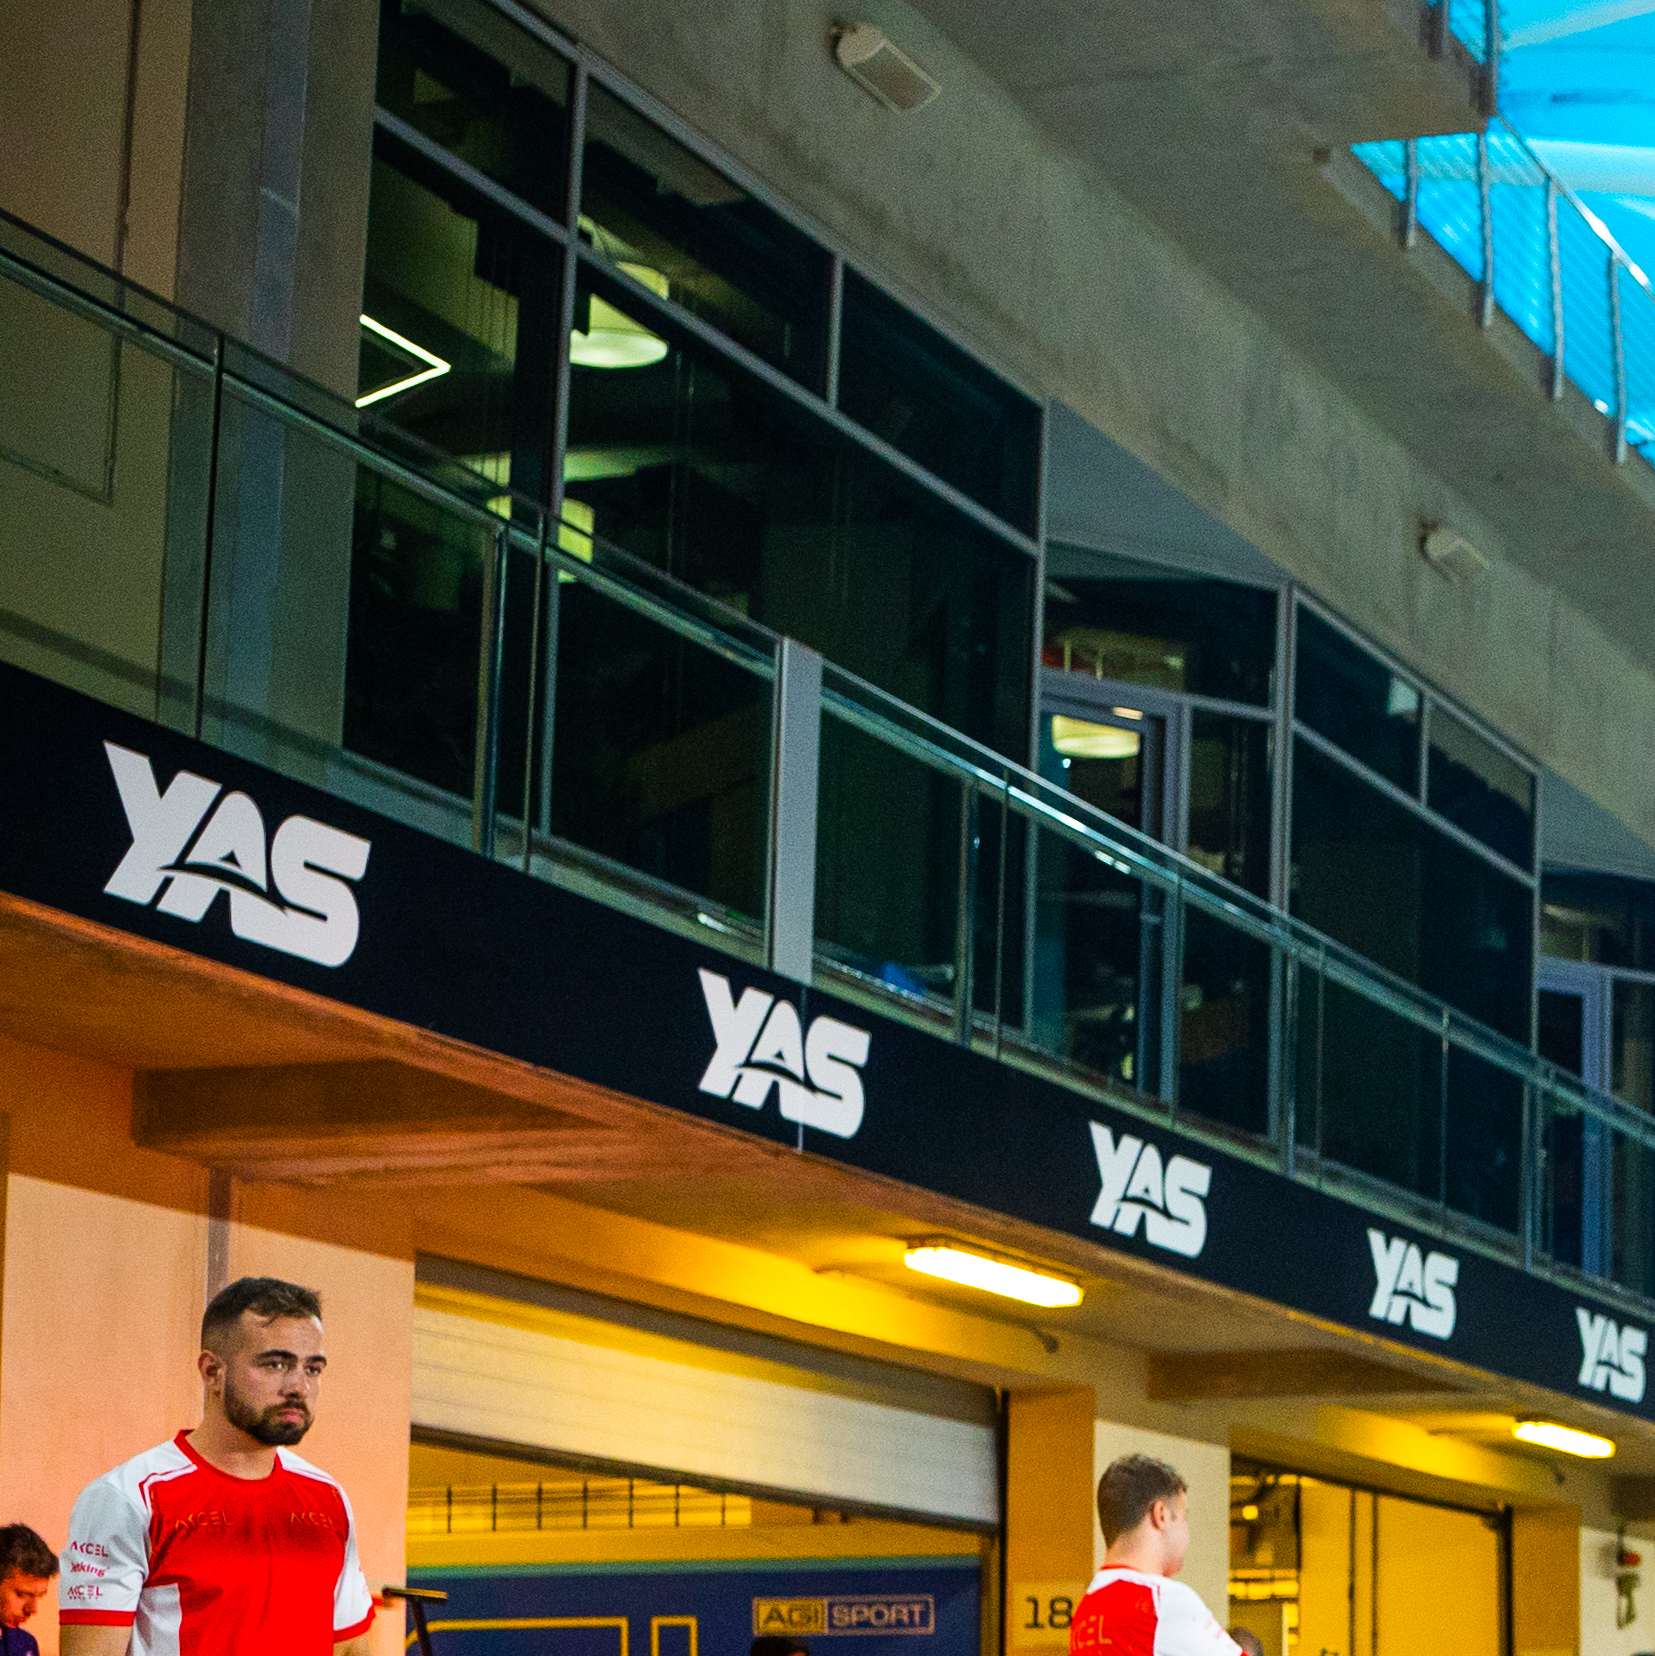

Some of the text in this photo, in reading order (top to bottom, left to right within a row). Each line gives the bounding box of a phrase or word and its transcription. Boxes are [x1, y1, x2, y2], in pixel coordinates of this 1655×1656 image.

[103, 739, 371, 967] YAS
[697, 967, 871, 1139] YAS
[1089, 1120, 1211, 1259] YAS
[1368, 1228, 1459, 1340] YAS
[1576, 1307, 1648, 1403] YAS
[831, 1603, 926, 1627] SPORT
[1024, 1597, 1073, 1630] 18
